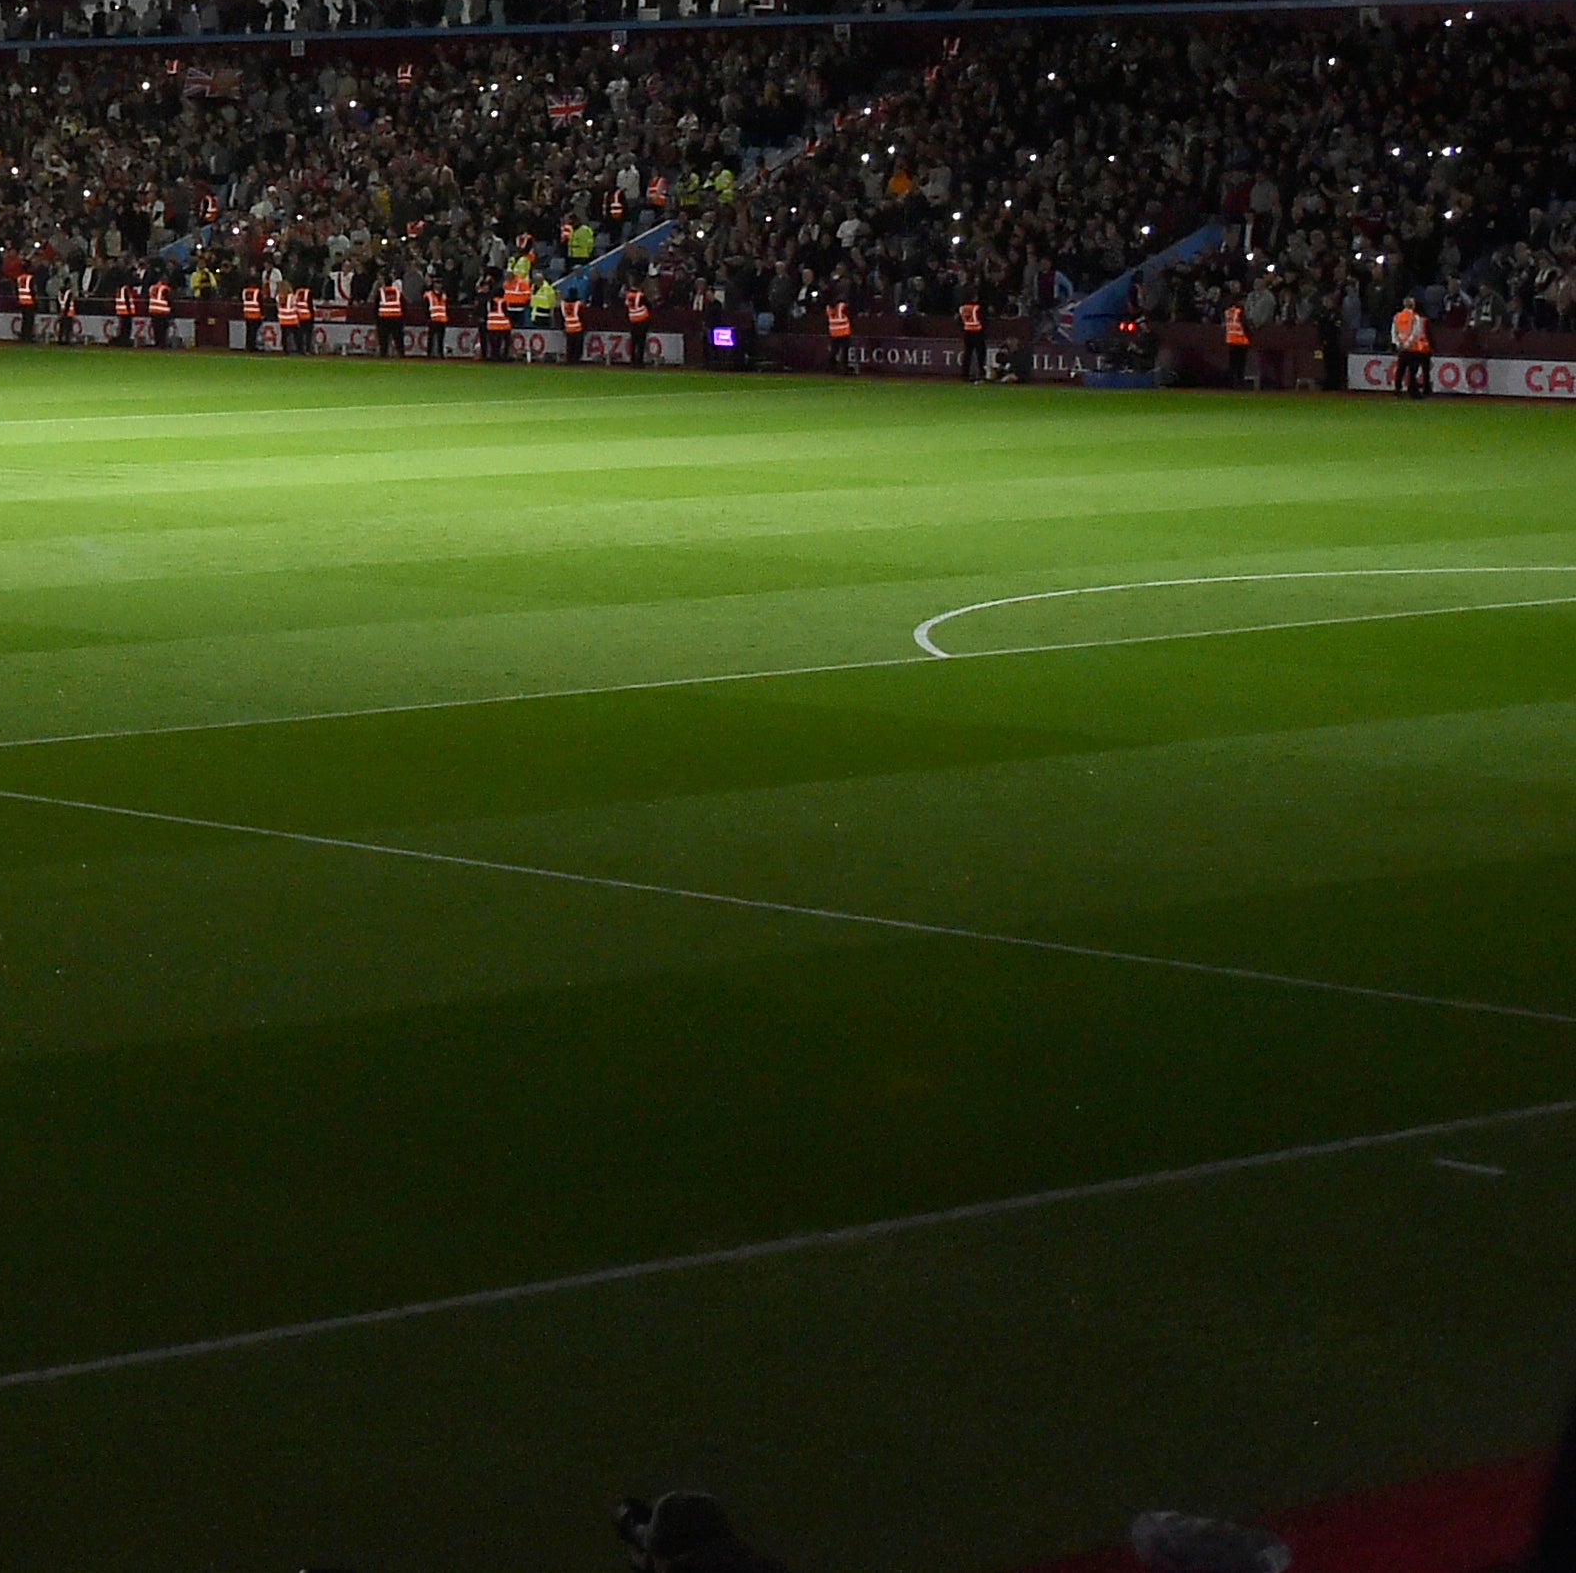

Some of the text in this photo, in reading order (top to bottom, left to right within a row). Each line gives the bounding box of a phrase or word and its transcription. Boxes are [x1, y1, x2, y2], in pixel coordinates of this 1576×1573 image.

[457, 331, 546, 354] COO
[588, 334, 662, 359] AZO
[846, 347, 932, 366] ELCOME
[1032, 354, 1082, 371] ILLA
[1364, 359, 1489, 389] CAOO
